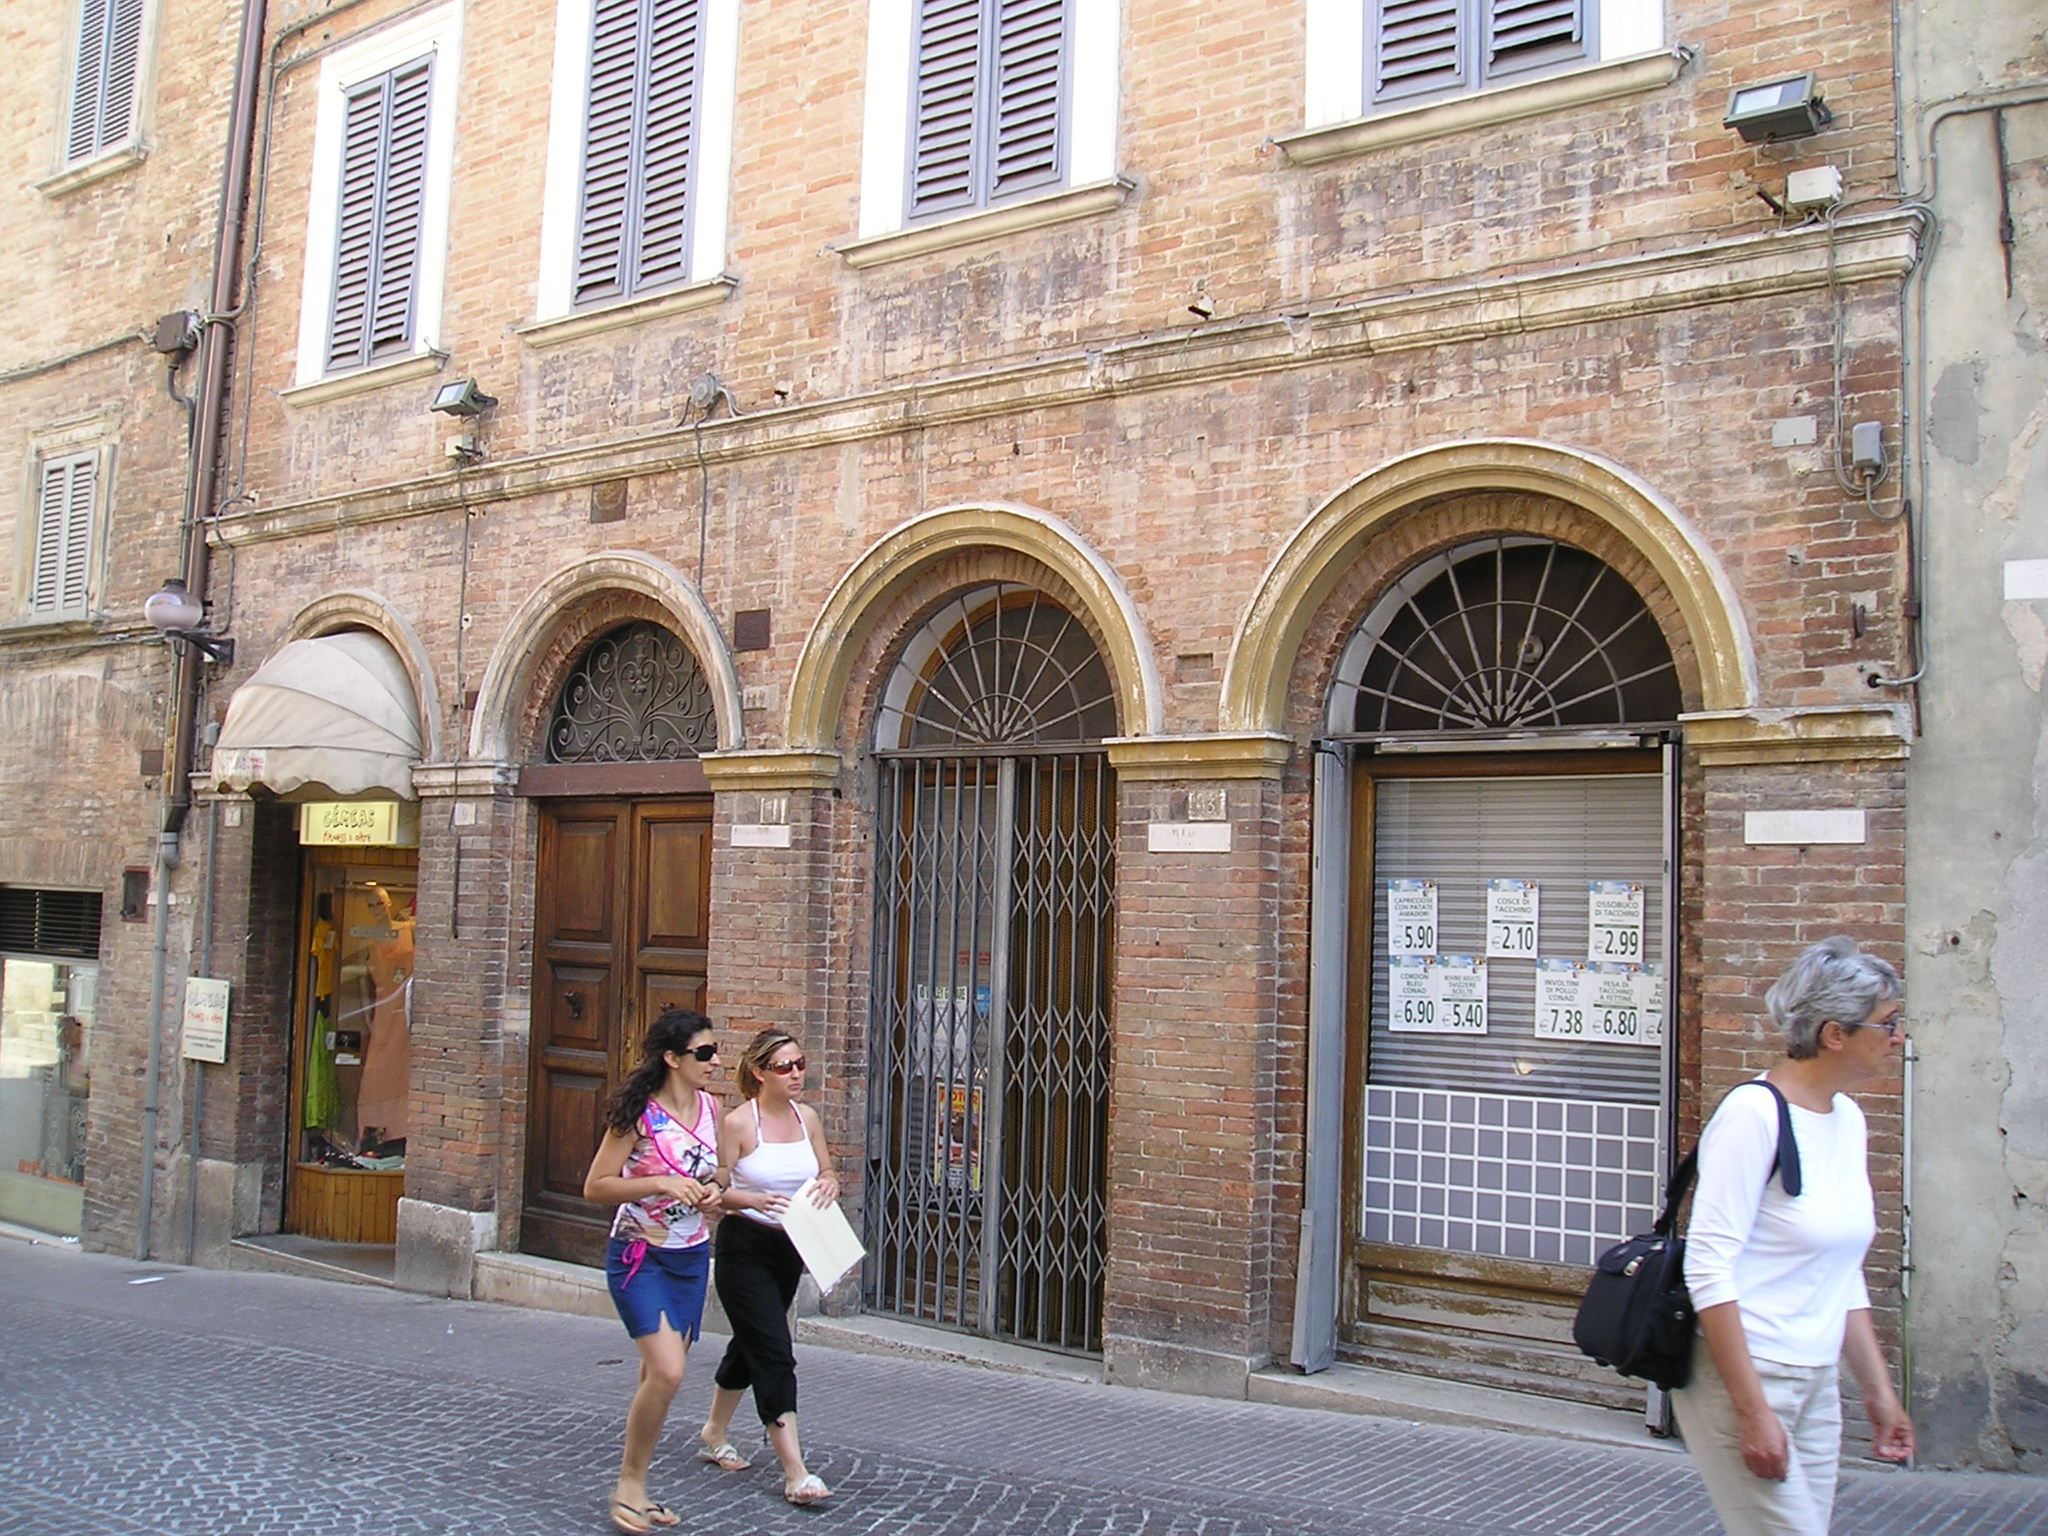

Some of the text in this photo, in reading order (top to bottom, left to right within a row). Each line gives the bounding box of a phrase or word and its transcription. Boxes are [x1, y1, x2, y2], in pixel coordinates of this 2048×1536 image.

[1405, 925, 1434, 949] 5.90
[1502, 925, 1534, 951] 2.10
[1604, 930, 1639, 956] 2.99
[1404, 999, 1435, 1024] 6.90
[1453, 1003, 1483, 1028] 5.40
[1550, 1009, 1583, 1034] 7.38
[1603, 1009, 1637, 1036] 6.80
